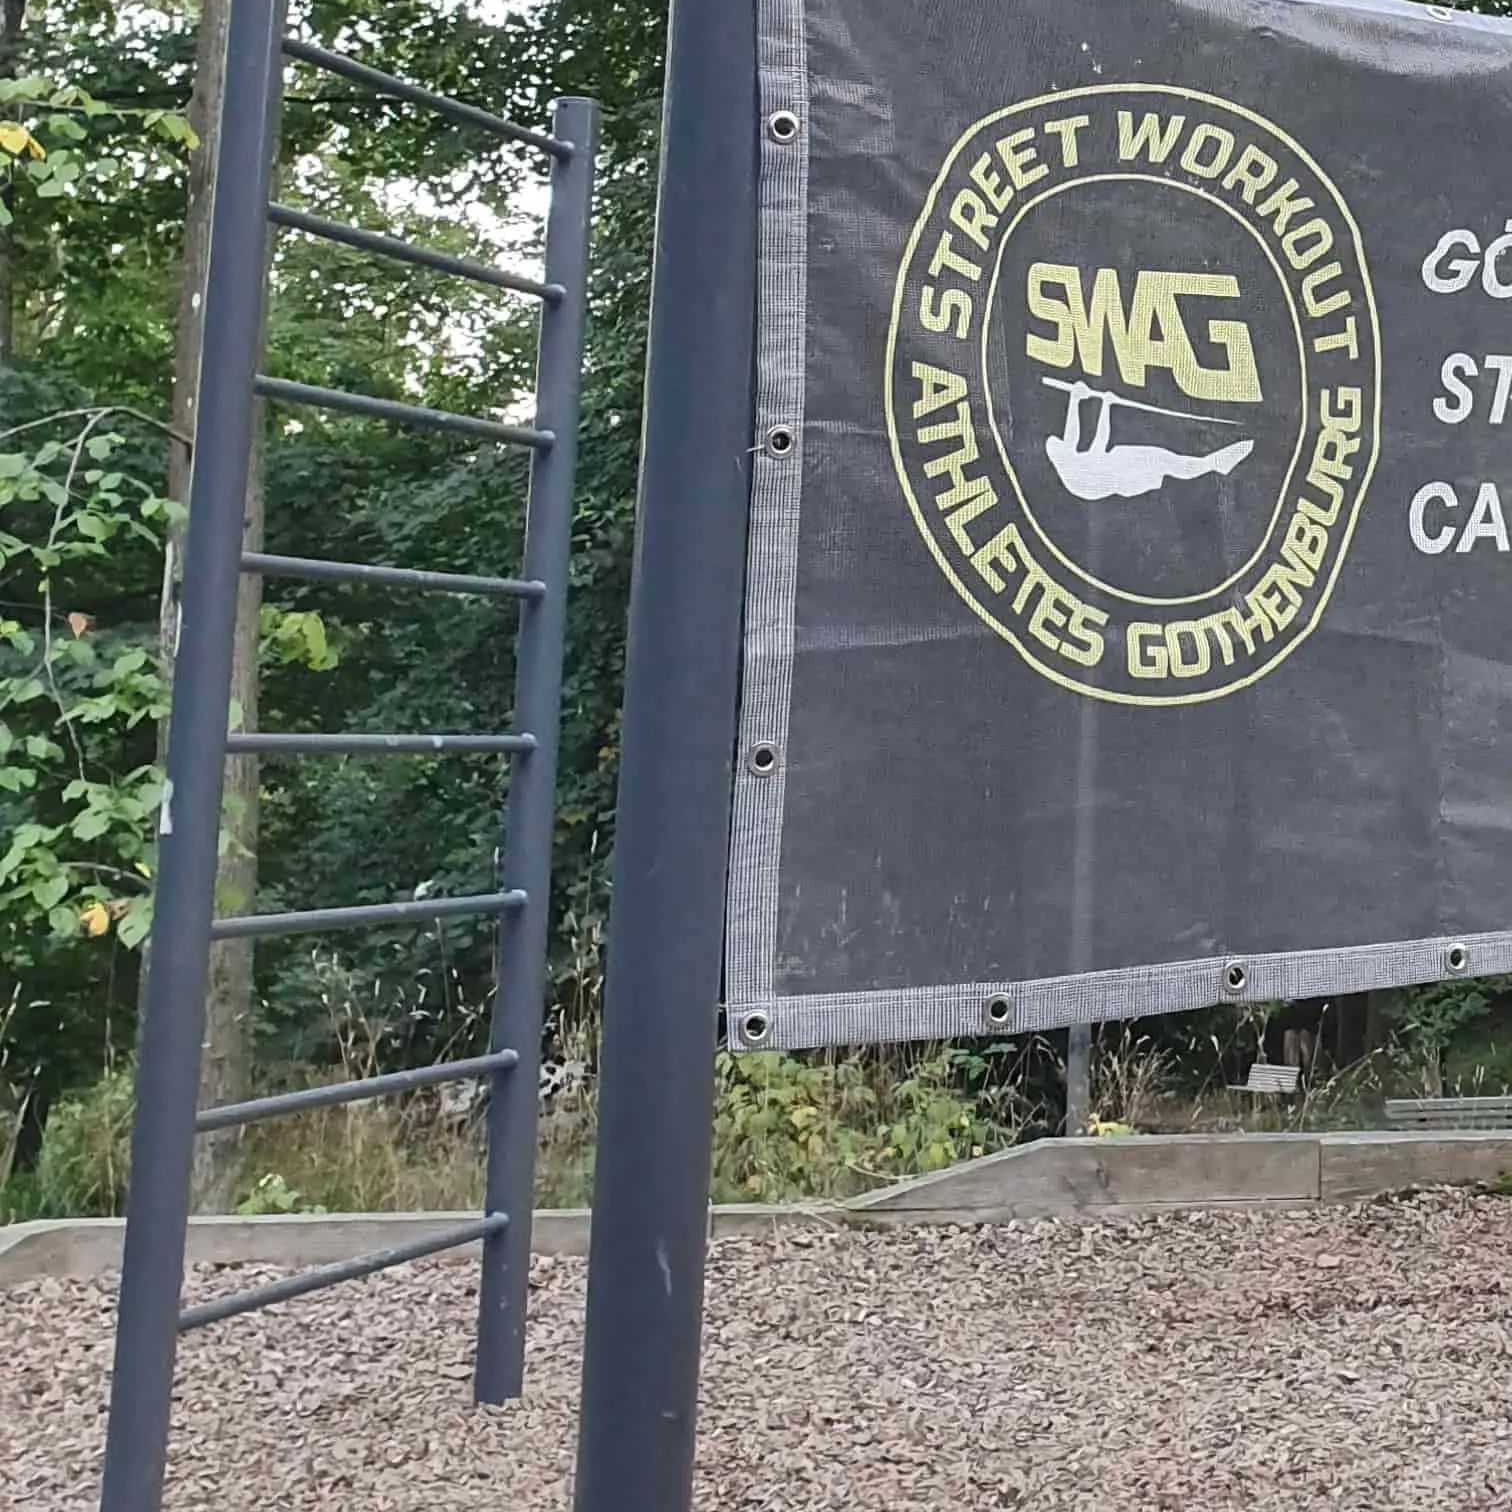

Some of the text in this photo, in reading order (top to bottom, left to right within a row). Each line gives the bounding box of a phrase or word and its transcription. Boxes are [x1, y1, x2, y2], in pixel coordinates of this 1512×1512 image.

[918, 110, 1359, 361] STREET WORKOUT
[1025, 262, 1263, 402] SWAG
[912, 361, 1361, 678] ATHLETES GOTHENBURG
